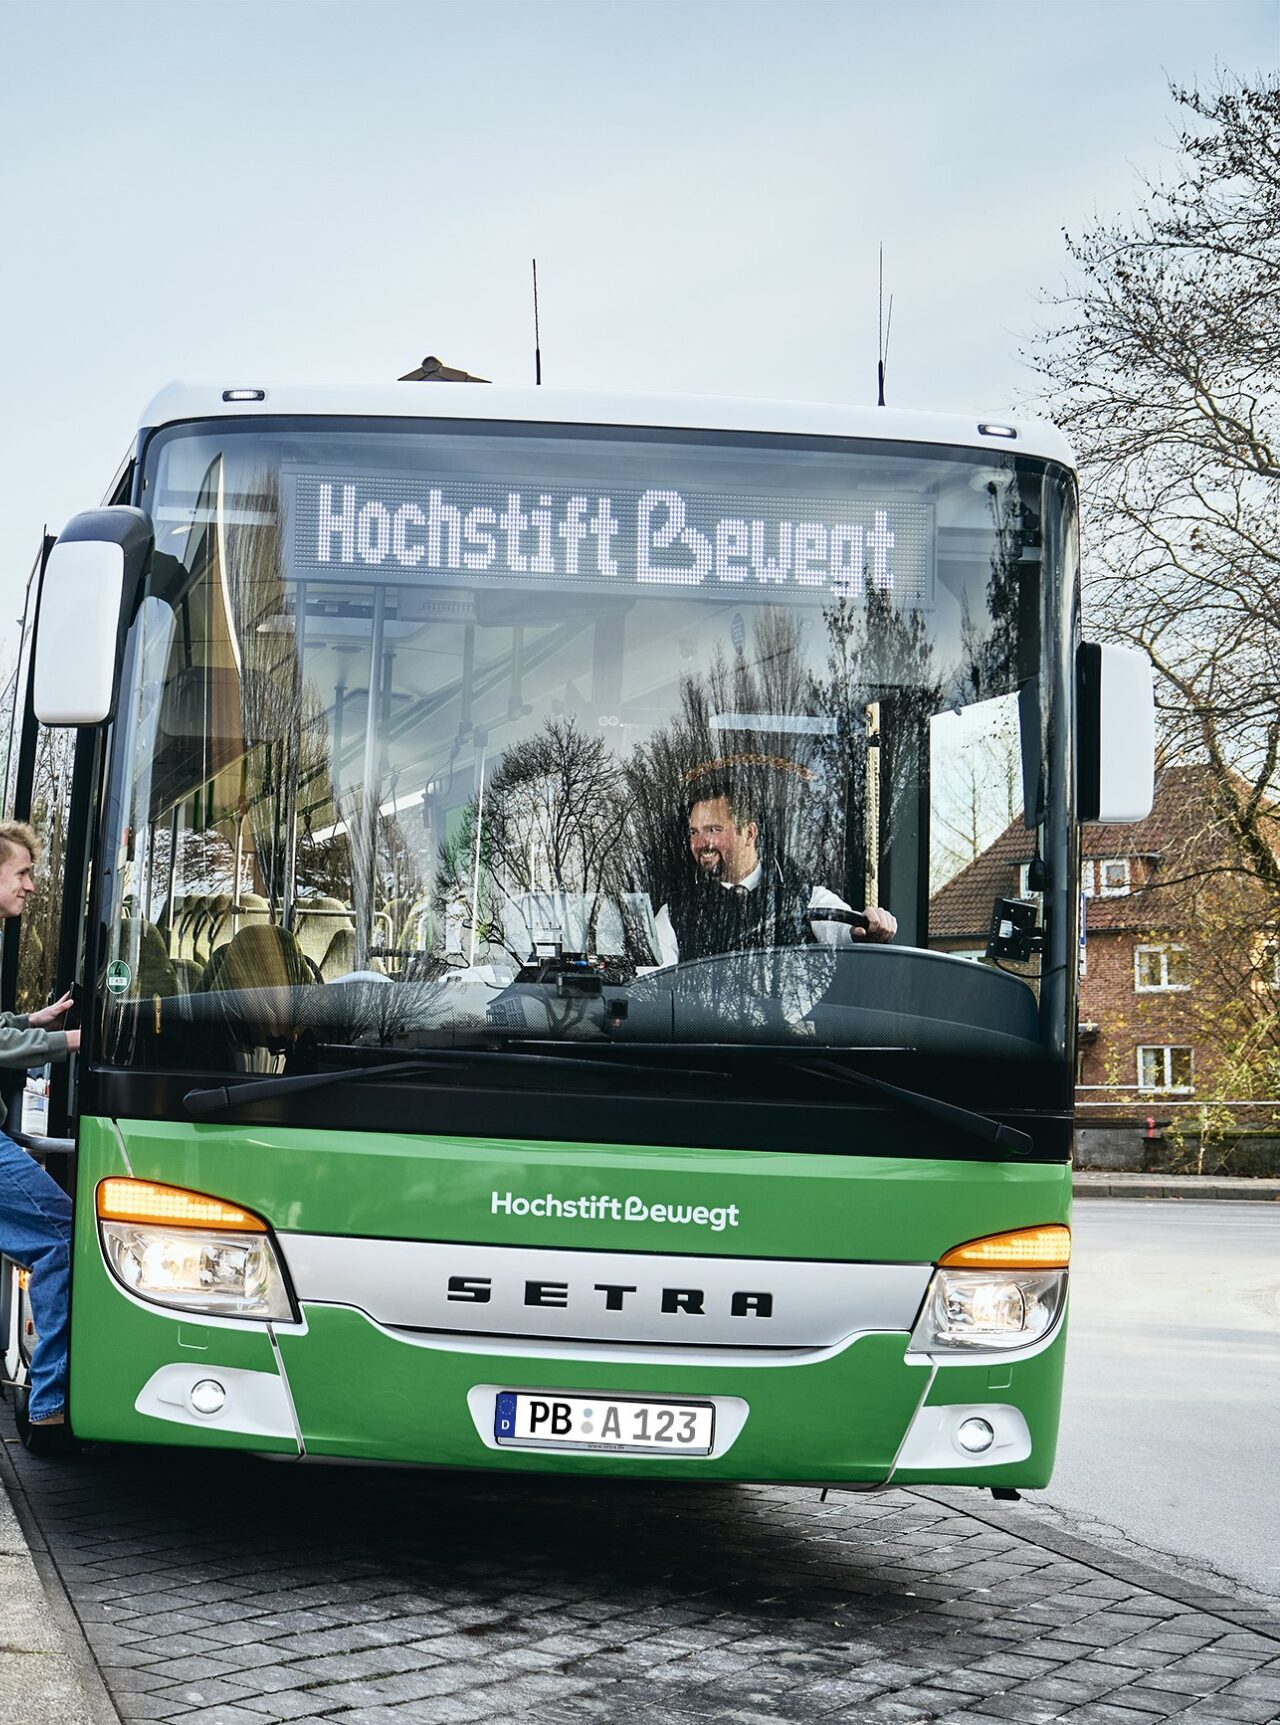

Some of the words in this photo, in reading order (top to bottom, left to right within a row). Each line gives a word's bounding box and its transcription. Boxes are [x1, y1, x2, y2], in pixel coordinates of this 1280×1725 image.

[318, 483, 619, 576] Hochstift
[637, 489, 896, 598] Bewegt
[446, 1275, 774, 1318] SETRA
[501, 1419, 510, 1430] D
[529, 1400, 572, 1435] PB
[601, 1406, 621, 1439] A
[632, 1408, 698, 1443] 123
